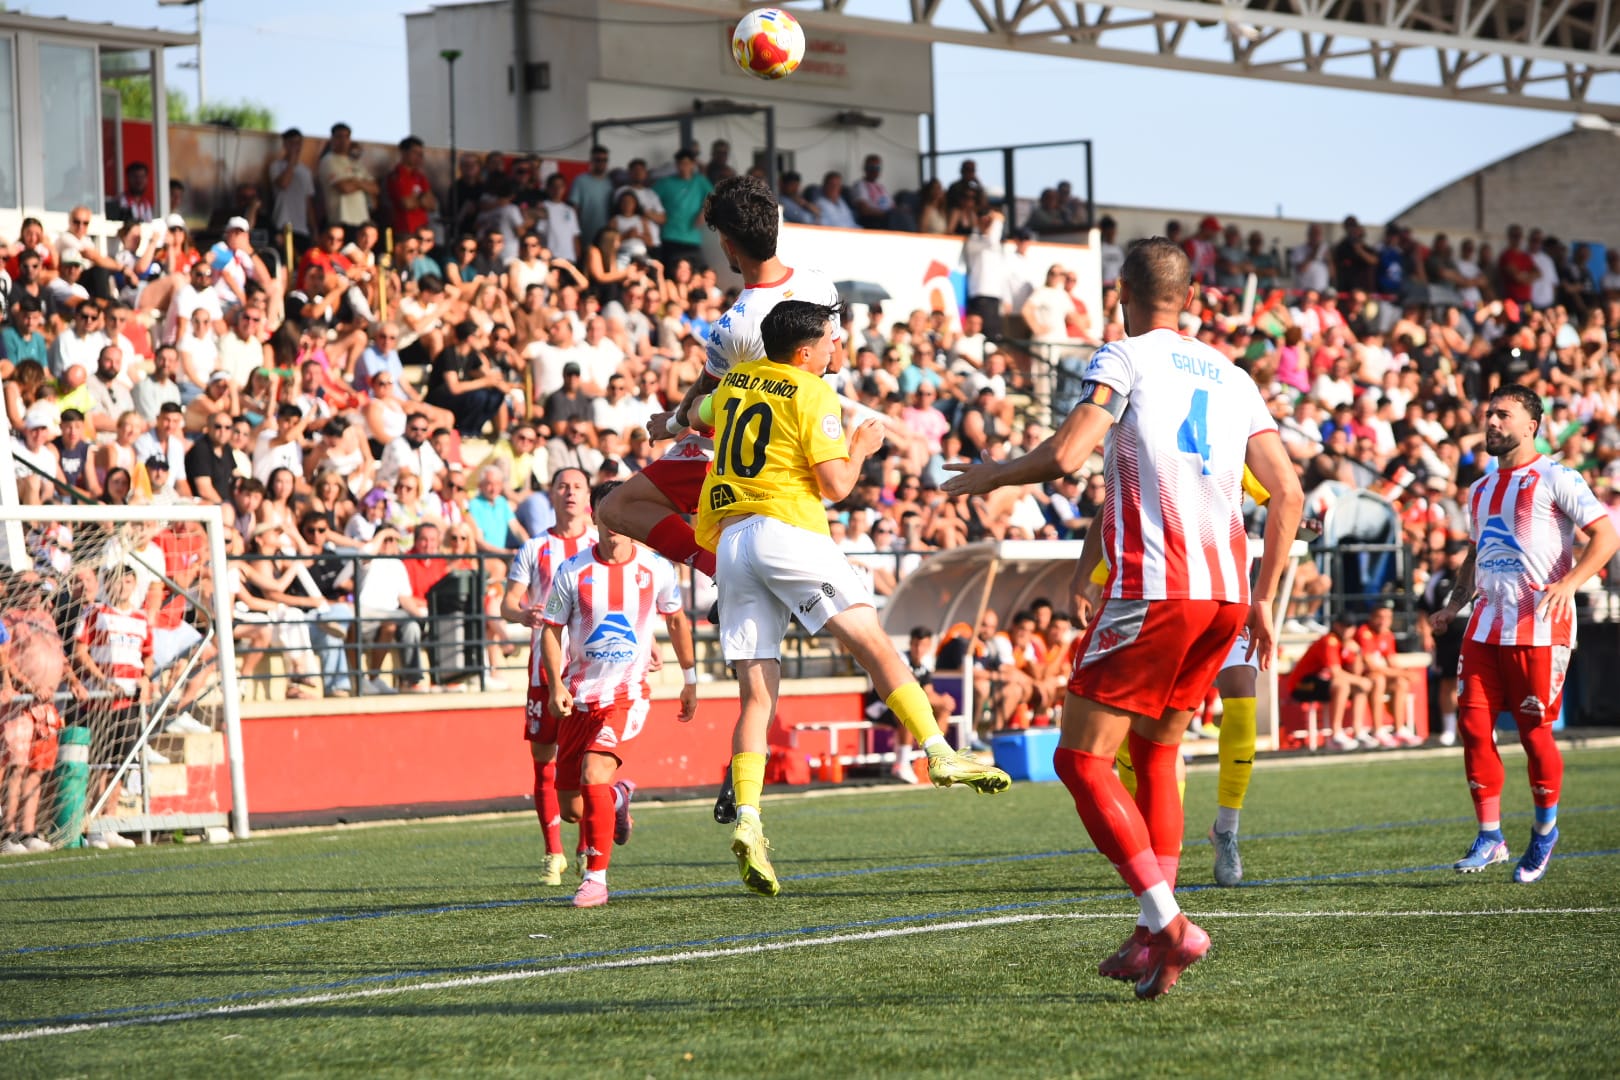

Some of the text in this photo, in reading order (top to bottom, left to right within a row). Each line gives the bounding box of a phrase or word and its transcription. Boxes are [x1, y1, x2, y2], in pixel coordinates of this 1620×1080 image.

[722, 372, 799, 399] PABLO MUÑOZ
[716, 397, 773, 479] 10
[1177, 388, 1212, 476] 4
[527, 698, 543, 718] 24
